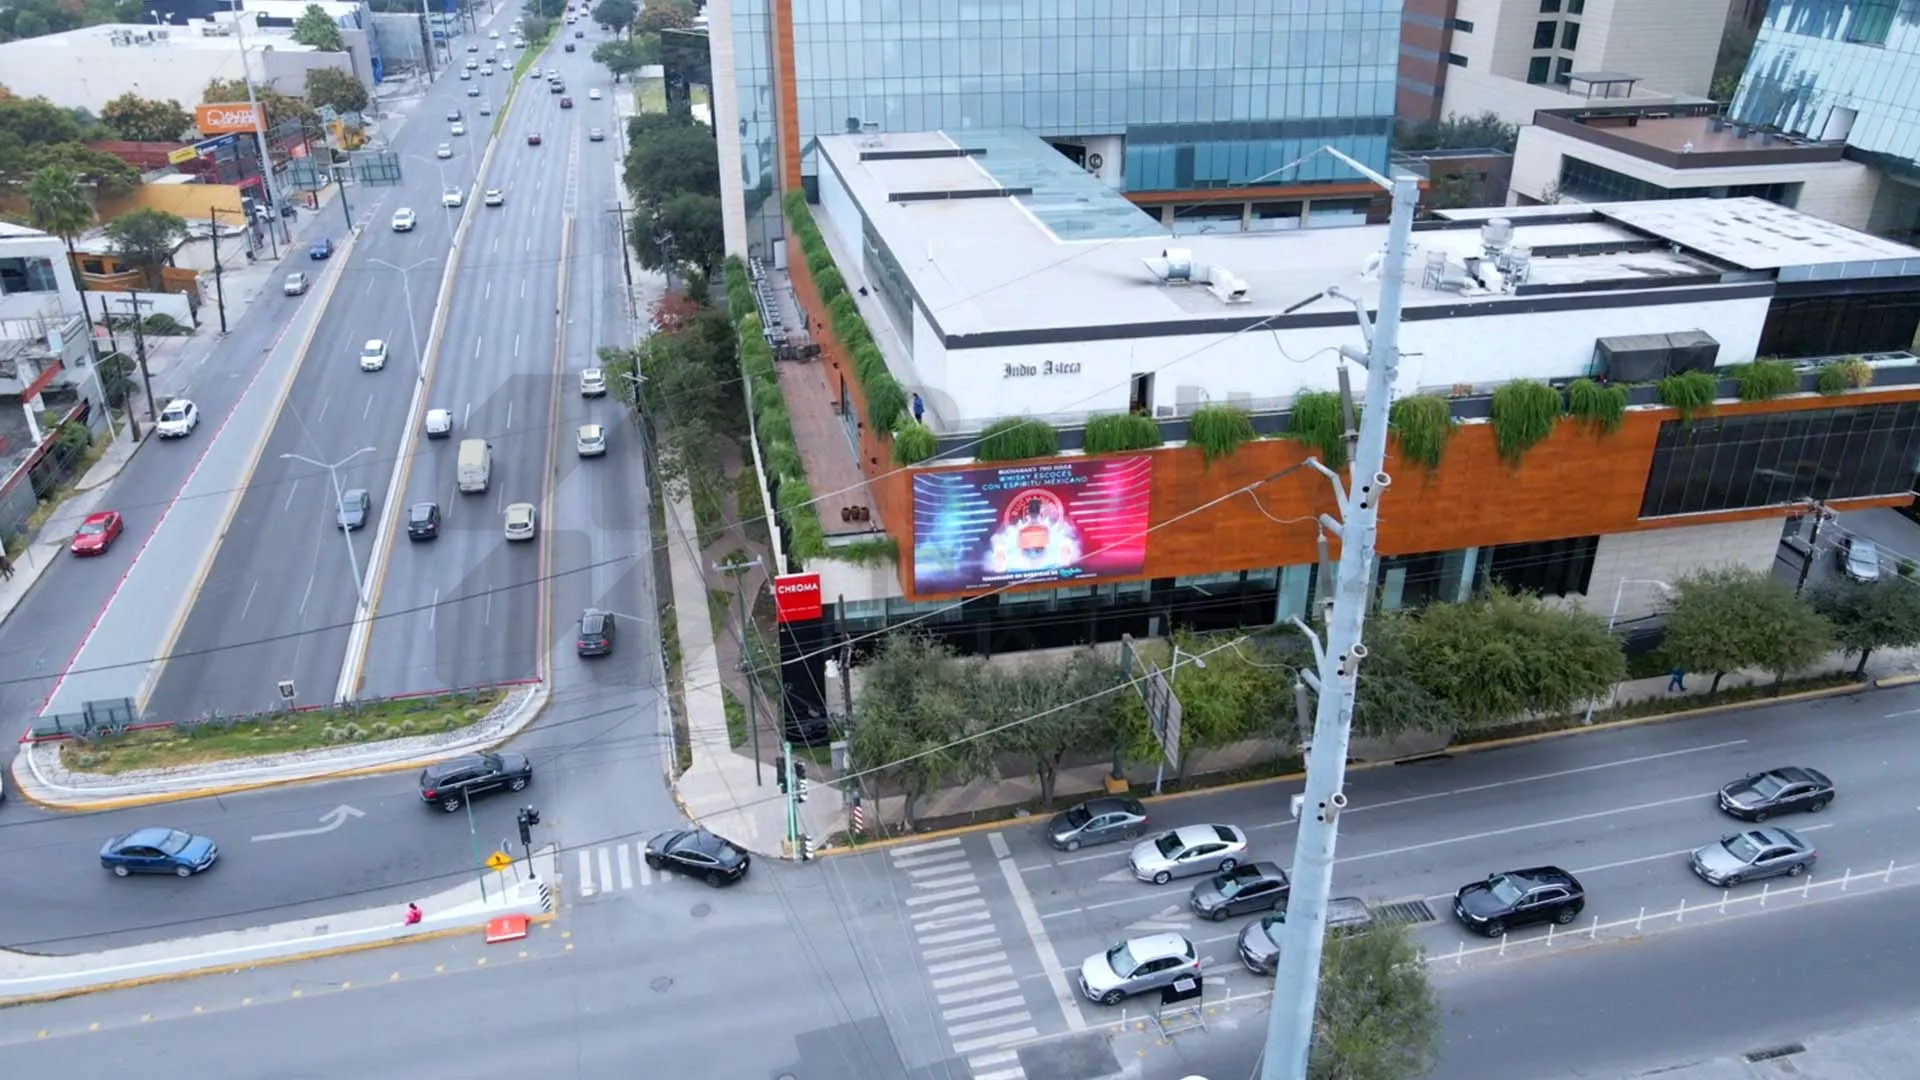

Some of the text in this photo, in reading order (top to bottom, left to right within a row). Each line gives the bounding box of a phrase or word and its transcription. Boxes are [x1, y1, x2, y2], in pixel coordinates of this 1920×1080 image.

[1003, 362, 1037, 378] Indio
[982, 483, 1001, 491] CON
[778, 583, 818, 594] CHROMA
